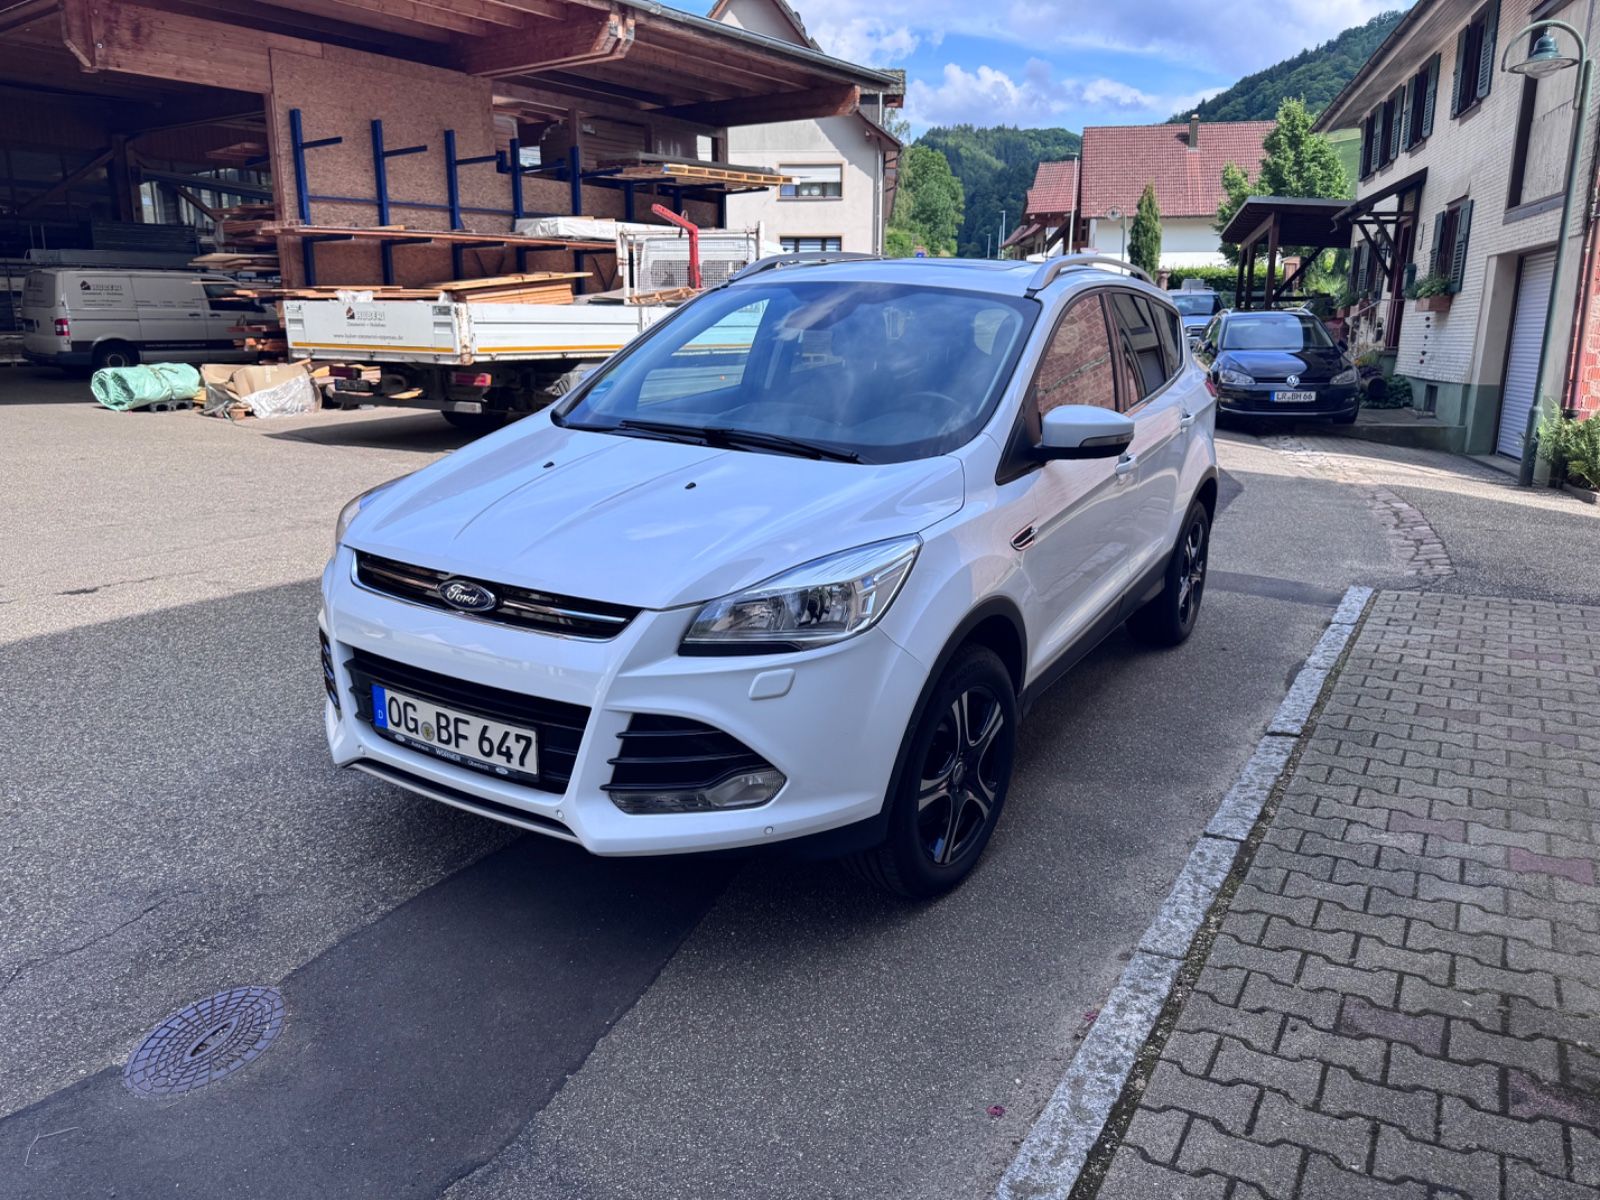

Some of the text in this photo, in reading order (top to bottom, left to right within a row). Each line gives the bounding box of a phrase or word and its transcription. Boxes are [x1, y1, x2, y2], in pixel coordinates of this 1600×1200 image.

[1276, 392, 1287, 400] LR
[1303, 392, 1313, 400] 66
[446, 583, 480, 606] Ford
[378, 709, 384, 719] D
[387, 696, 533, 767] OG BF 647
